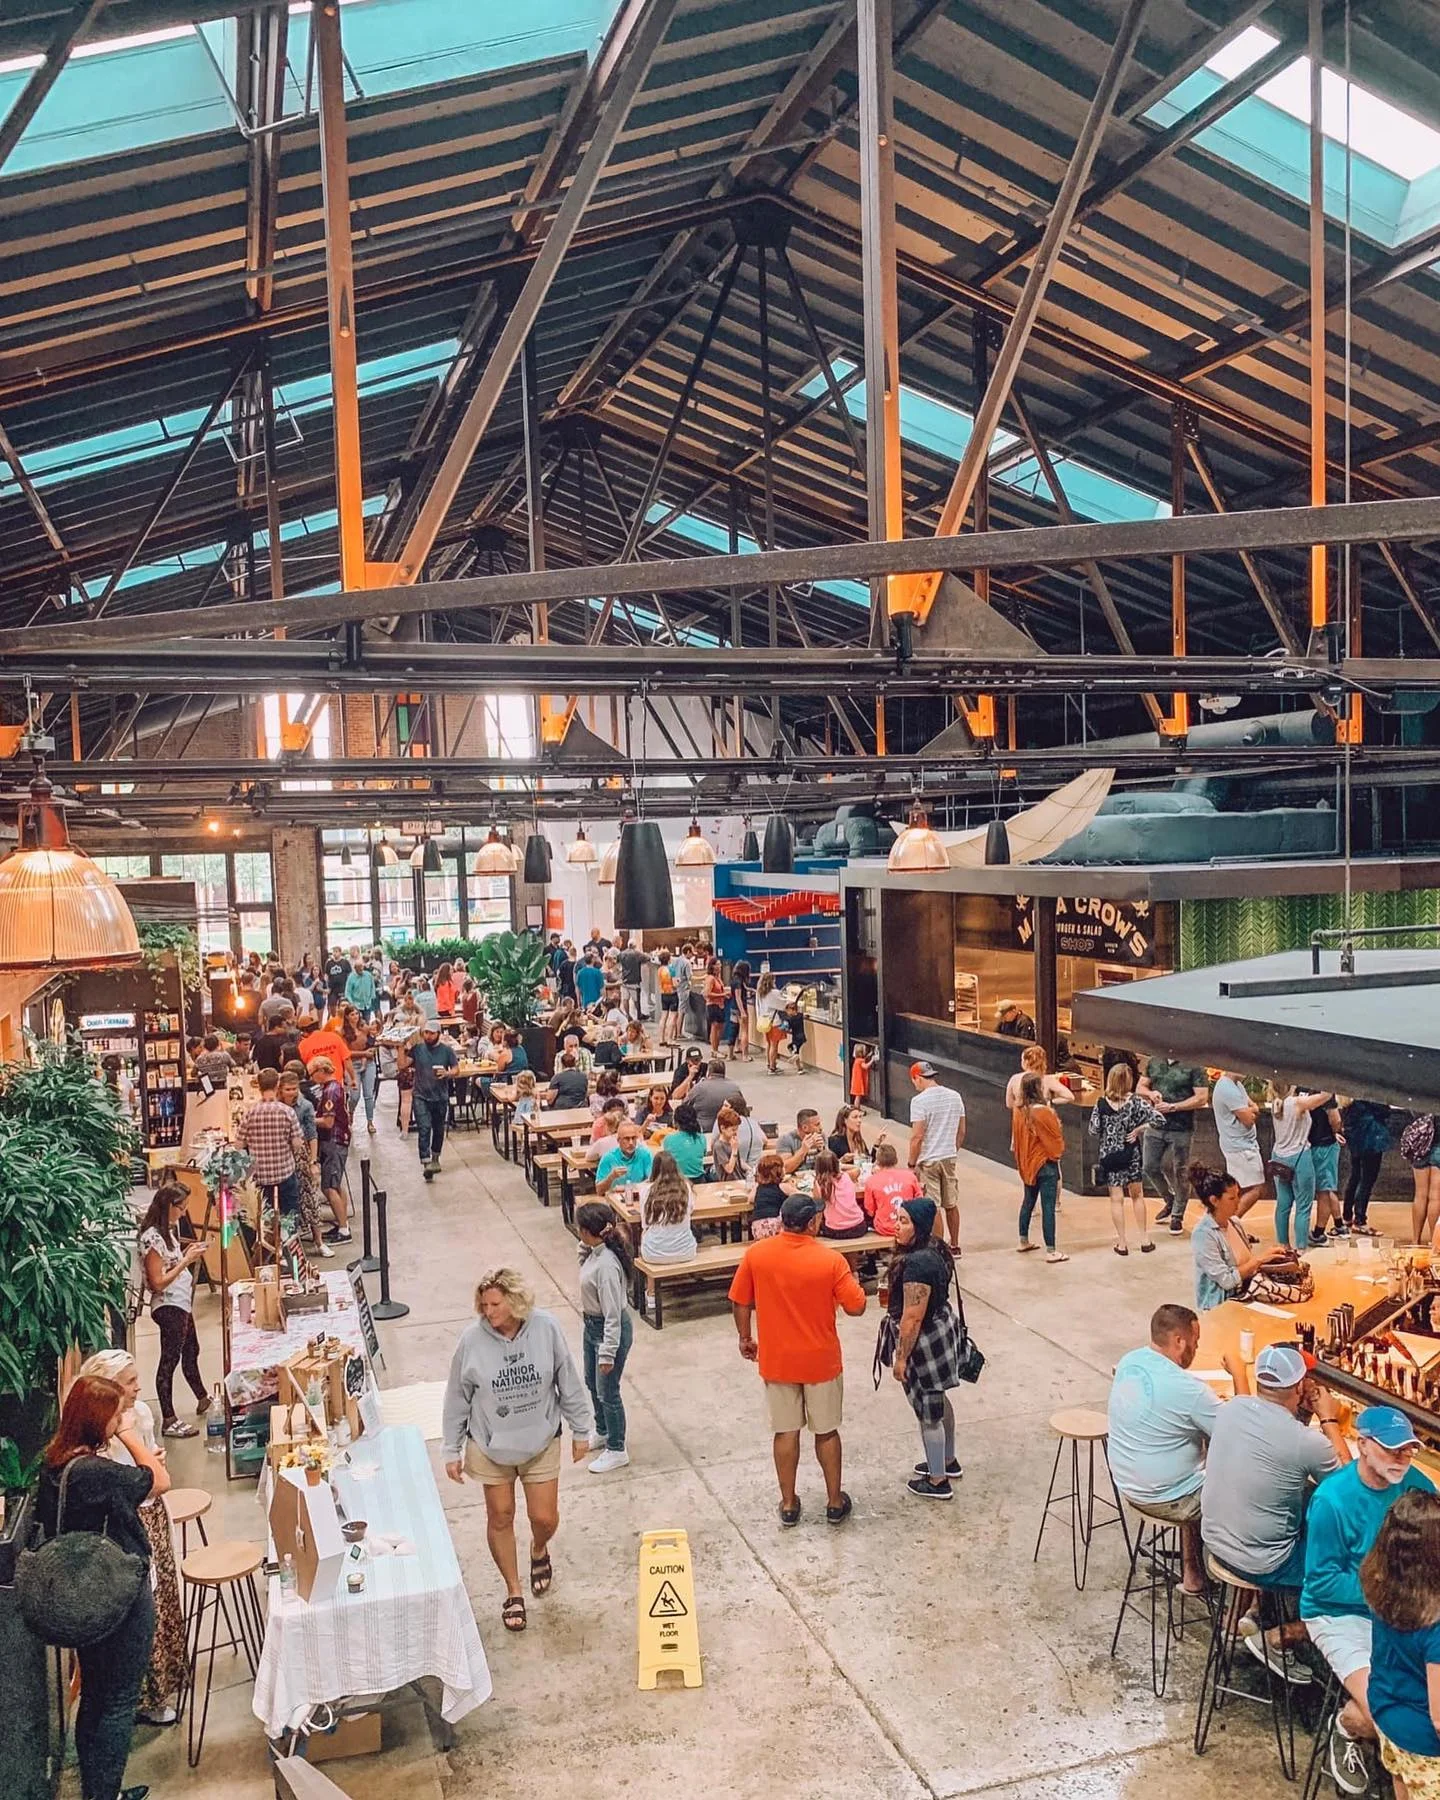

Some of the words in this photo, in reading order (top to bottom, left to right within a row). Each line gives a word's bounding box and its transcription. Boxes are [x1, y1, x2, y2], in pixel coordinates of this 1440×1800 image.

[1074, 896, 1149, 957] CROW'S
[1082, 924, 1103, 936] SALAD
[1060, 936, 1095, 952] SHOP
[497, 1363, 535, 1379] JUNIOR
[491, 1371, 542, 1389] NATIONAL
[649, 1564, 685, 1575] CAUTION
[659, 1630, 679, 1638] FLOOR
